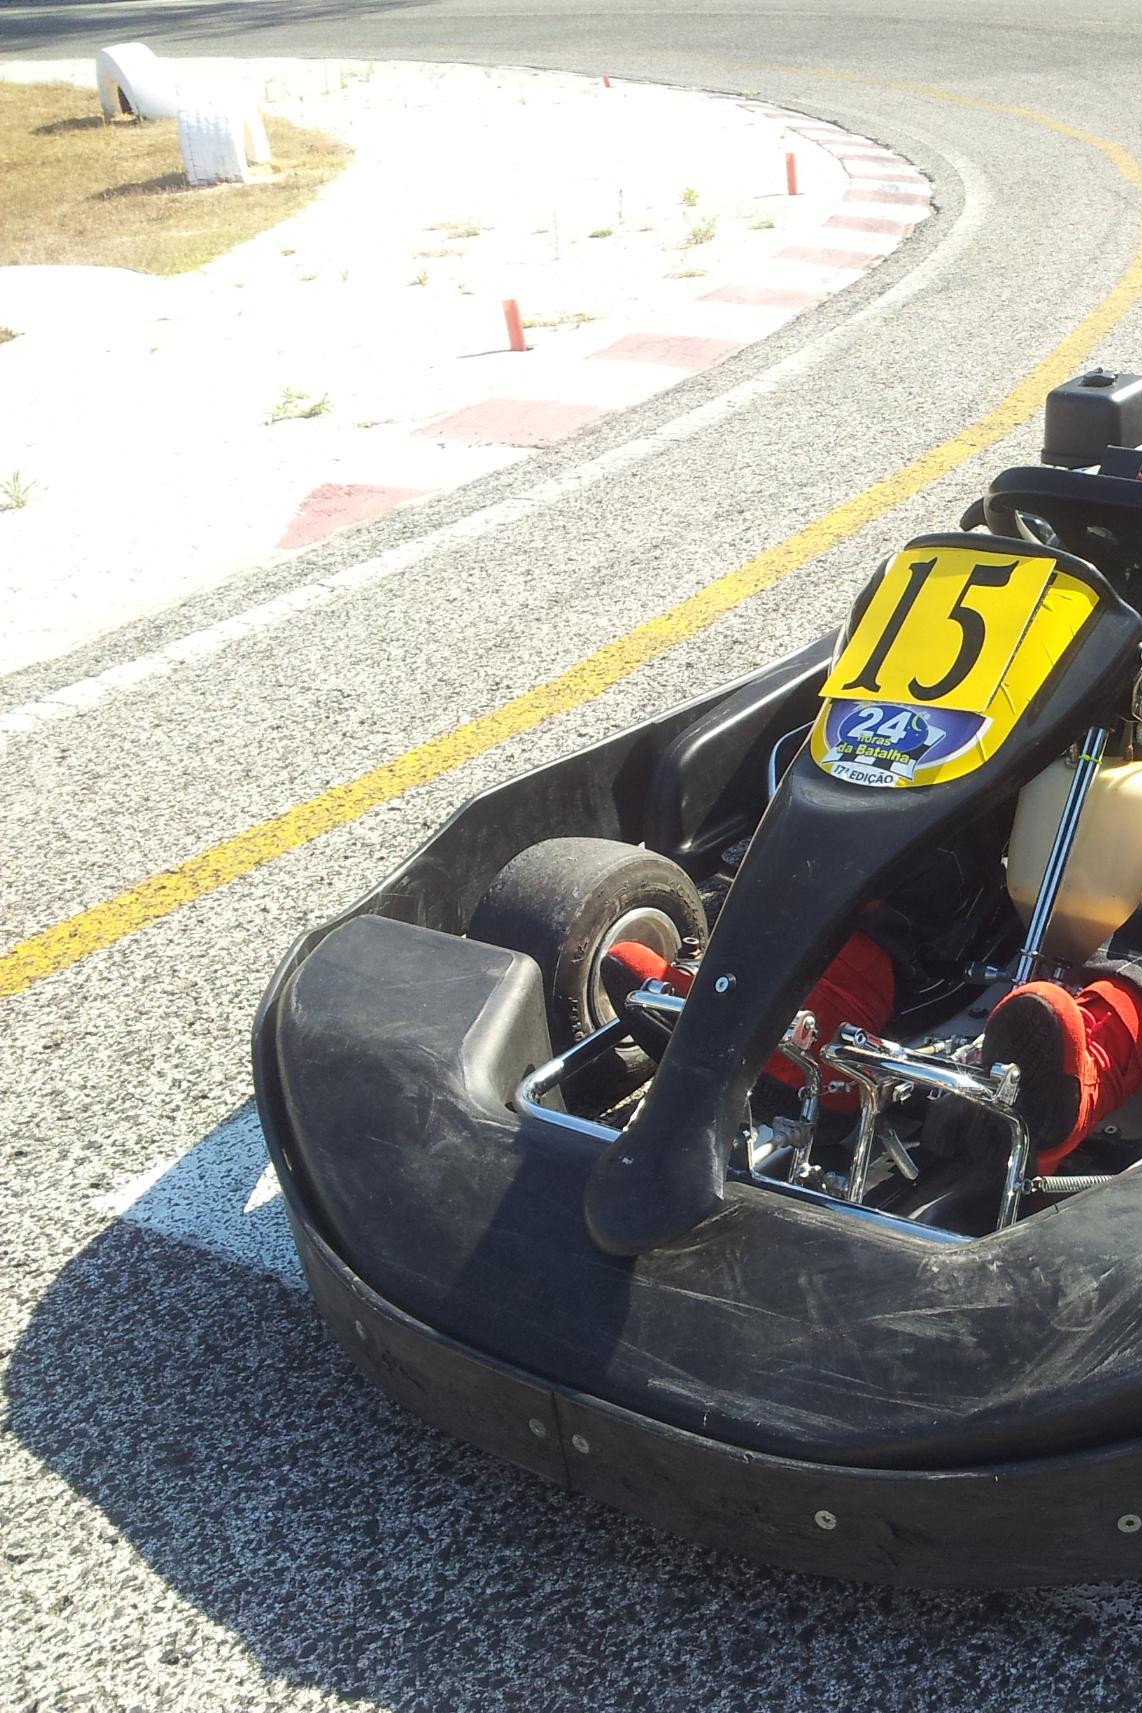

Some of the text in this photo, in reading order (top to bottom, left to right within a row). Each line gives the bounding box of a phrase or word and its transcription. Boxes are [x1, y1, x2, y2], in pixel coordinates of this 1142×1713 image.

[842, 557, 1020, 701] 15
[847, 707, 912, 743] 24
[857, 733, 892, 746] horas
[837, 743, 910, 765] da Batalha
[849, 770, 893, 784] EDIÇÃO
